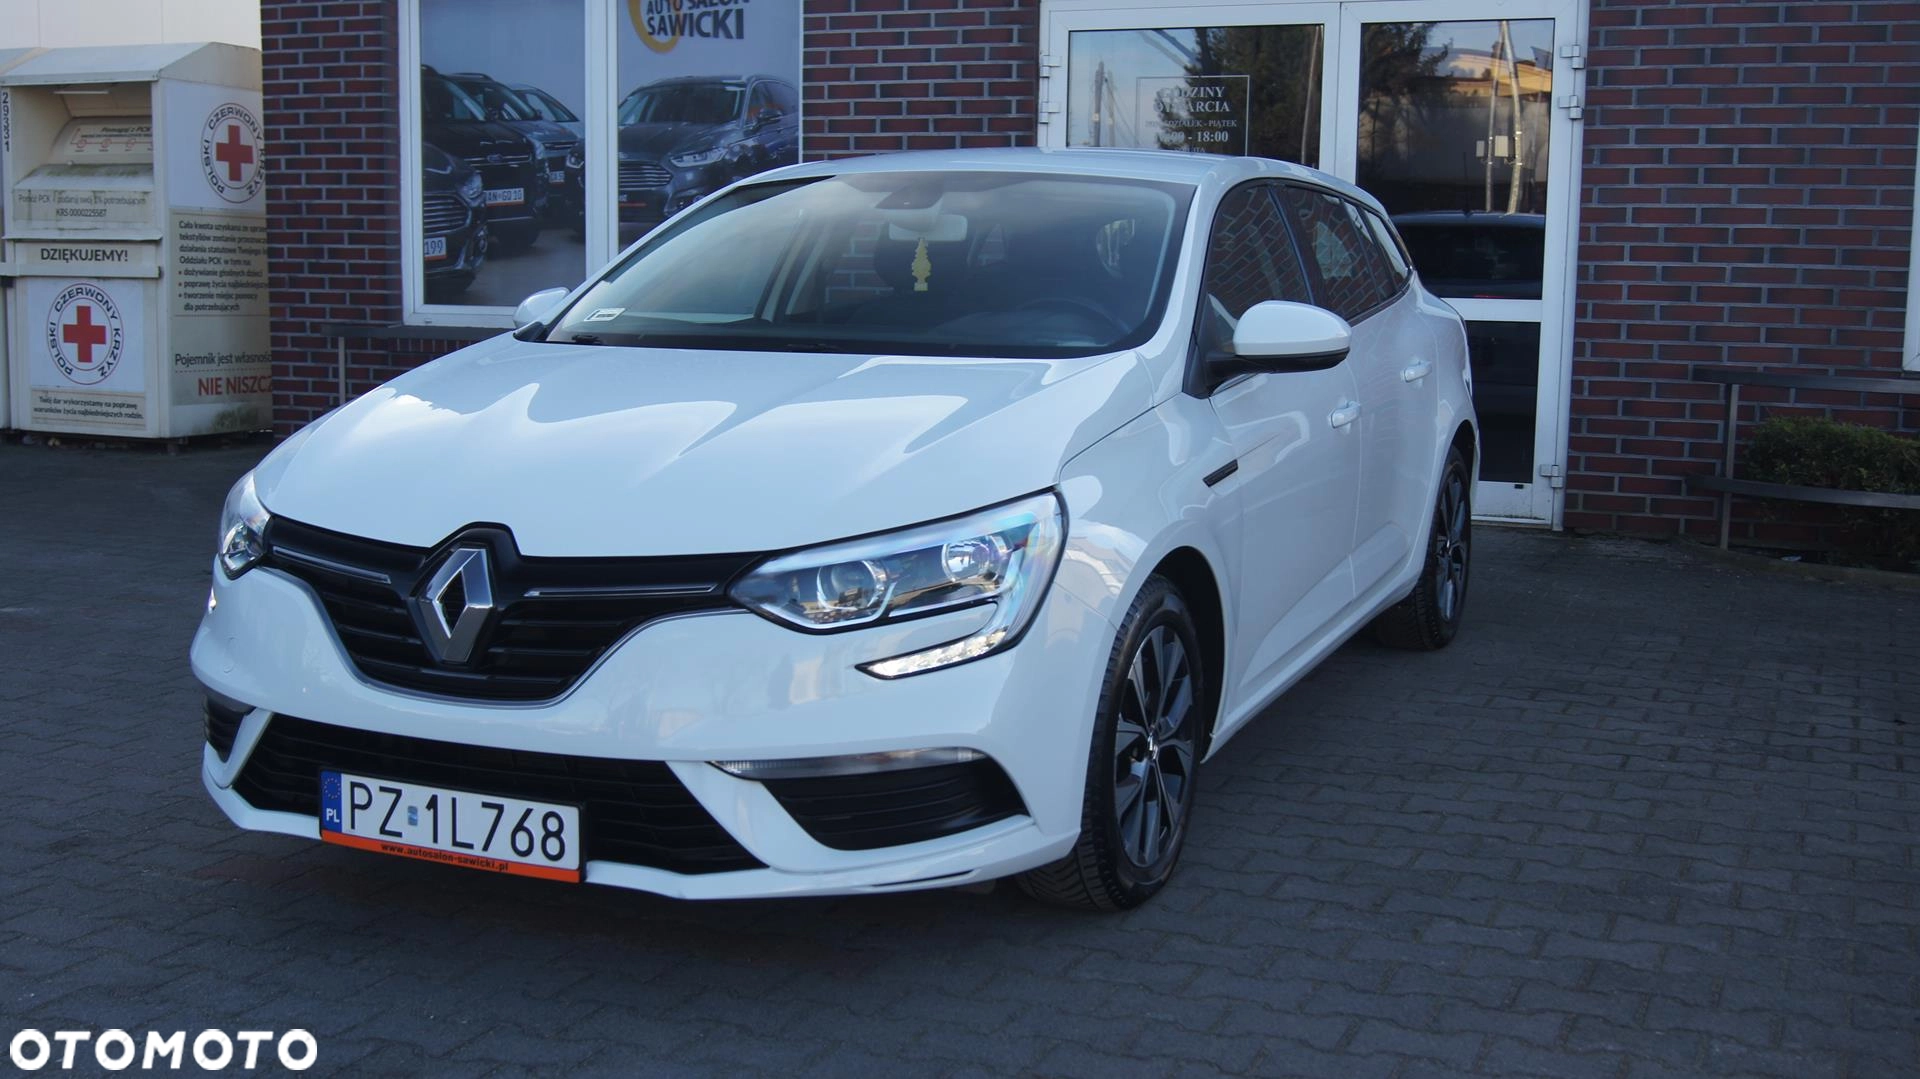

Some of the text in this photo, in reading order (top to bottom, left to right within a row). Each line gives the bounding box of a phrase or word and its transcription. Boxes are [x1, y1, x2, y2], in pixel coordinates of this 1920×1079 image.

[647, 0, 683, 15] AUTO
[647, 9, 744, 39] SAWICKI
[208, 106, 262, 140] CZERWONY
[1208, 119, 1237, 128] PIĄTEK
[1197, 130, 1229, 142] 18:00
[203, 139, 225, 194] POLSKI
[40, 248, 129, 263] DZIĘKUJEMY!
[54, 287, 118, 320] CZERWONY
[49, 321, 73, 375] POLSKI
[175, 352, 217, 367] Pojemnik
[217, 352, 233, 366] jest
[198, 377, 223, 396] NIE
[326, 808, 340, 823] PL
[350, 781, 566, 861] PZ 1L768
[381, 843, 509, 871] www.autosalon-sawicki.pl
